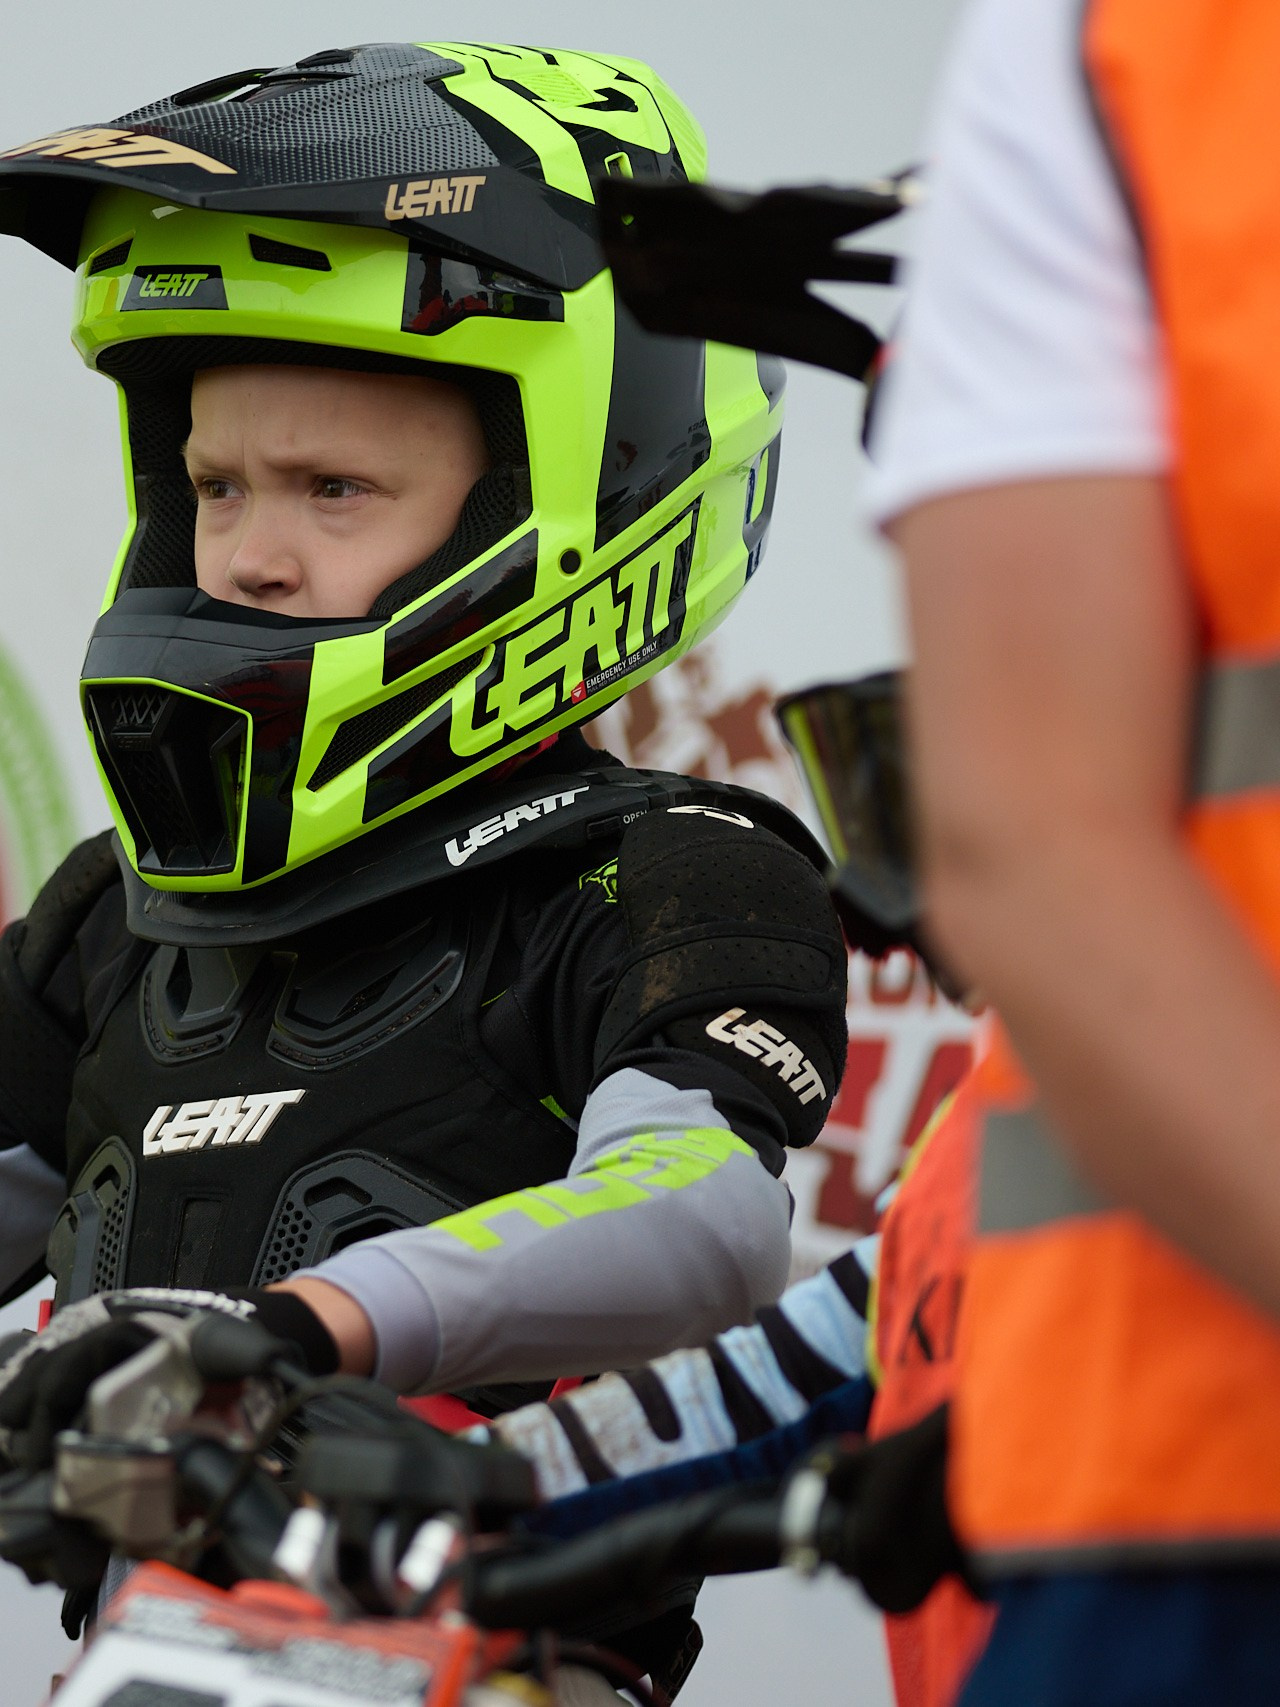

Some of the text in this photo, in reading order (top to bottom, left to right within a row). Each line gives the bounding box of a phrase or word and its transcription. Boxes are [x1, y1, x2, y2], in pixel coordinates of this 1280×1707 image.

[384, 175, 487, 221] LEATT
[138, 272, 210, 298] LEATT
[449, 508, 695, 757] LEATT
[586, 640, 658, 689] EMERGENCY USE ONLY
[443, 785, 590, 867] LEATT
[705, 1006, 826, 1106] LEATT
[142, 1088, 307, 1158] LEATT
